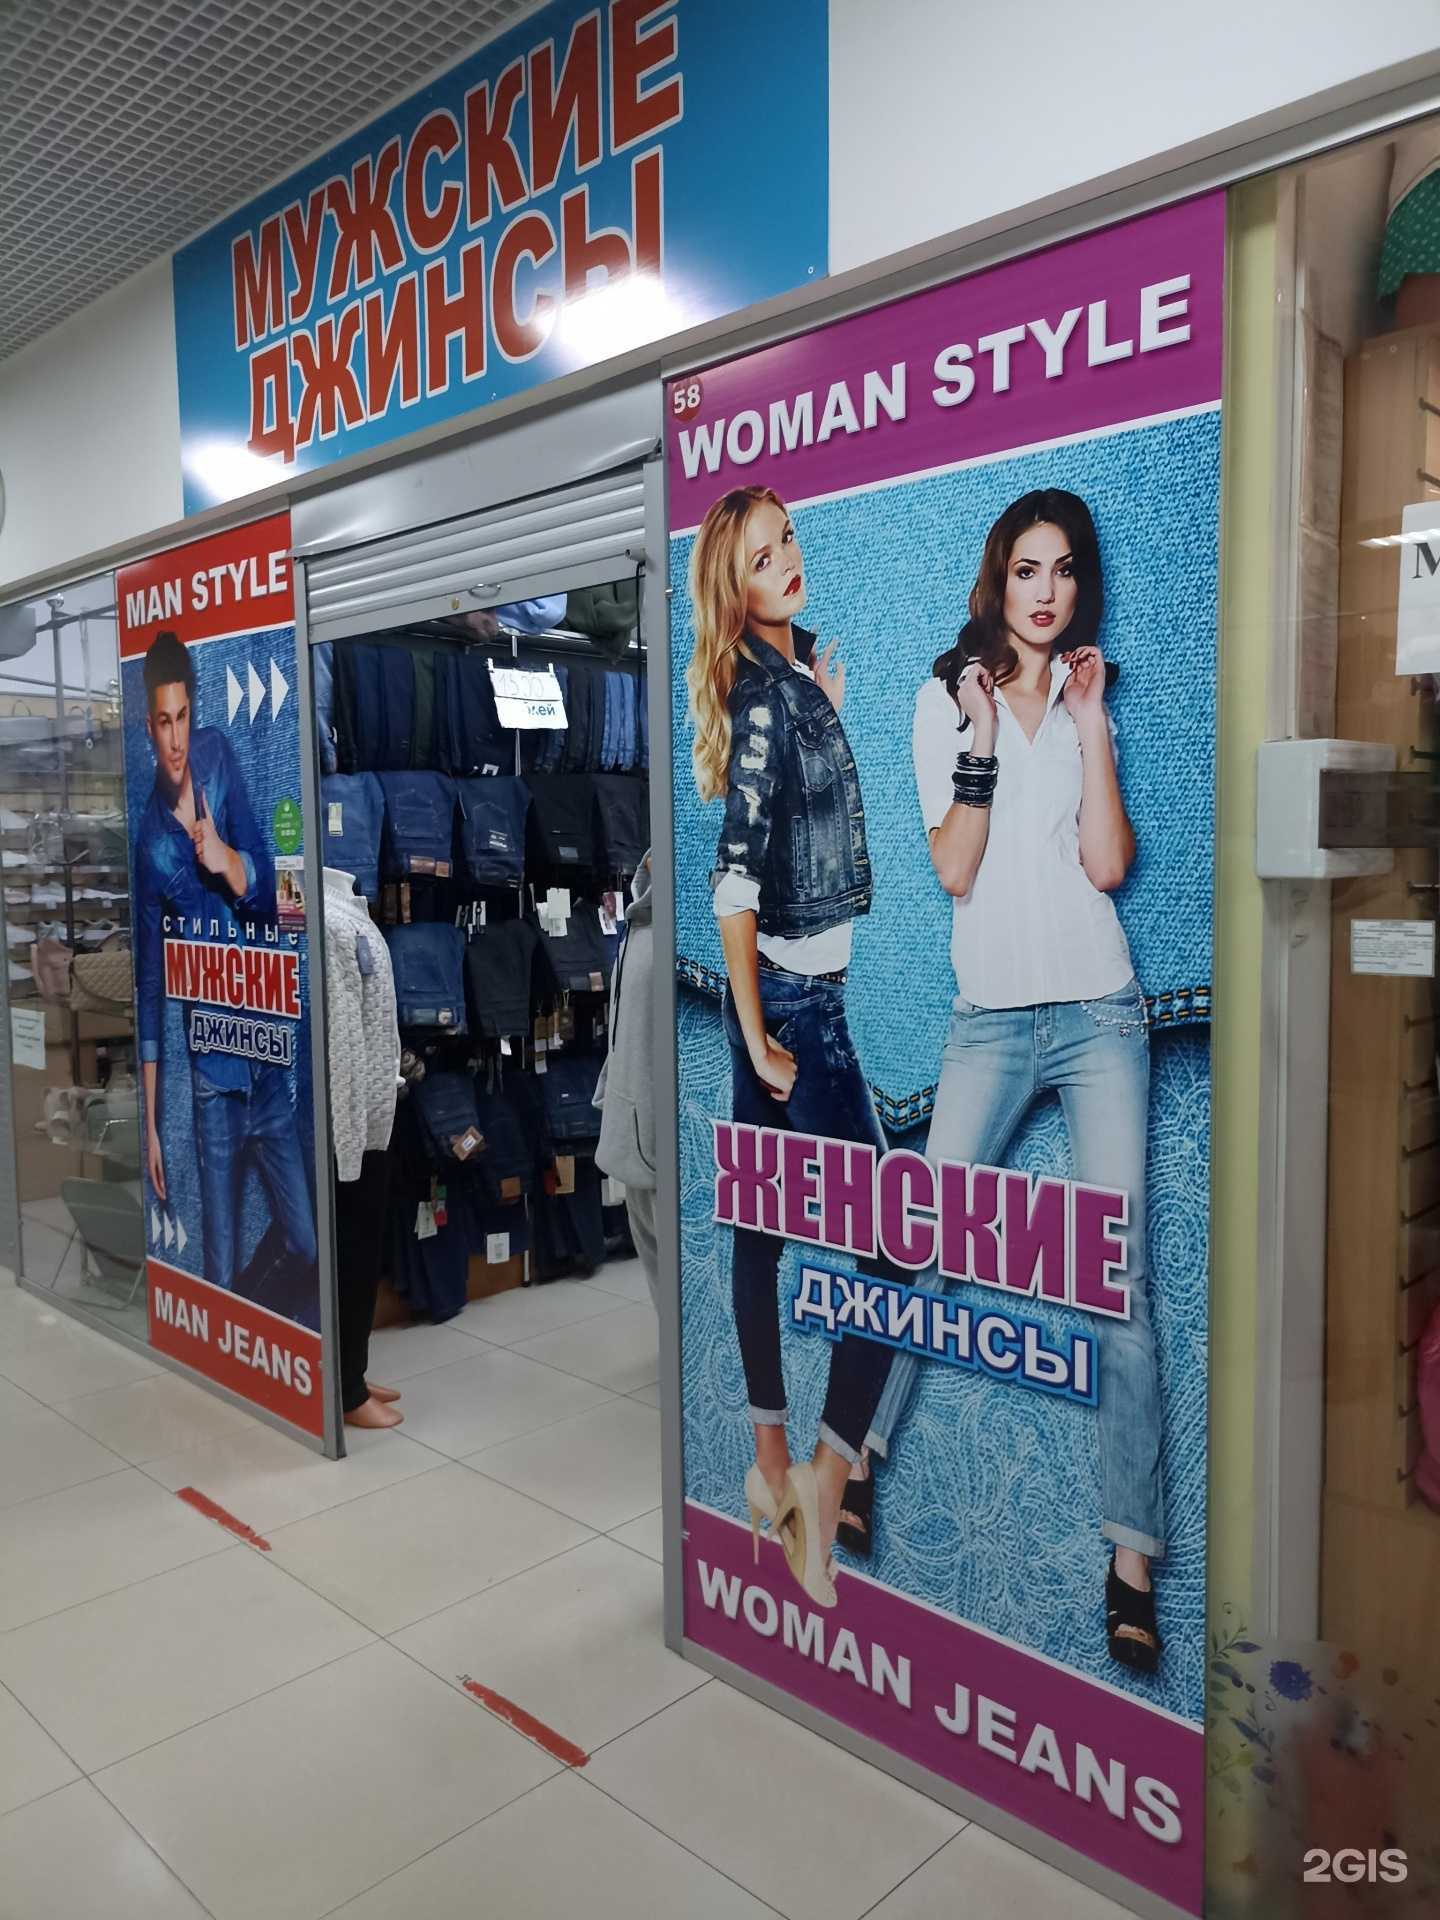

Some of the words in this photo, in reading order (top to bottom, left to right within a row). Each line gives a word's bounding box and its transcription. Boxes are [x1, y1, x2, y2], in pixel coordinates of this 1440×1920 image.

[231, 0, 683, 352] МУЖСКИЕ
[248, 145, 664, 465] ДЖИНСЫ
[678, 361, 907, 480] WOMAN
[931, 273, 1192, 408] STYLE
[673, 384, 701, 414] 58
[125, 578, 183, 629] MAN
[191, 549, 288, 611] STYLE
[164, 938, 301, 1019] МУЖСКИЕ
[712, 1119, 1131, 1321] ЖЕНСКИЕ
[154, 1286, 209, 1343] MAN
[217, 1319, 313, 1396] JEANS
[793, 1266, 1091, 1396] ДЖИНСЫ
[697, 1559, 912, 1709] WOMAN
[933, 1682, 1183, 1844] JEANS
